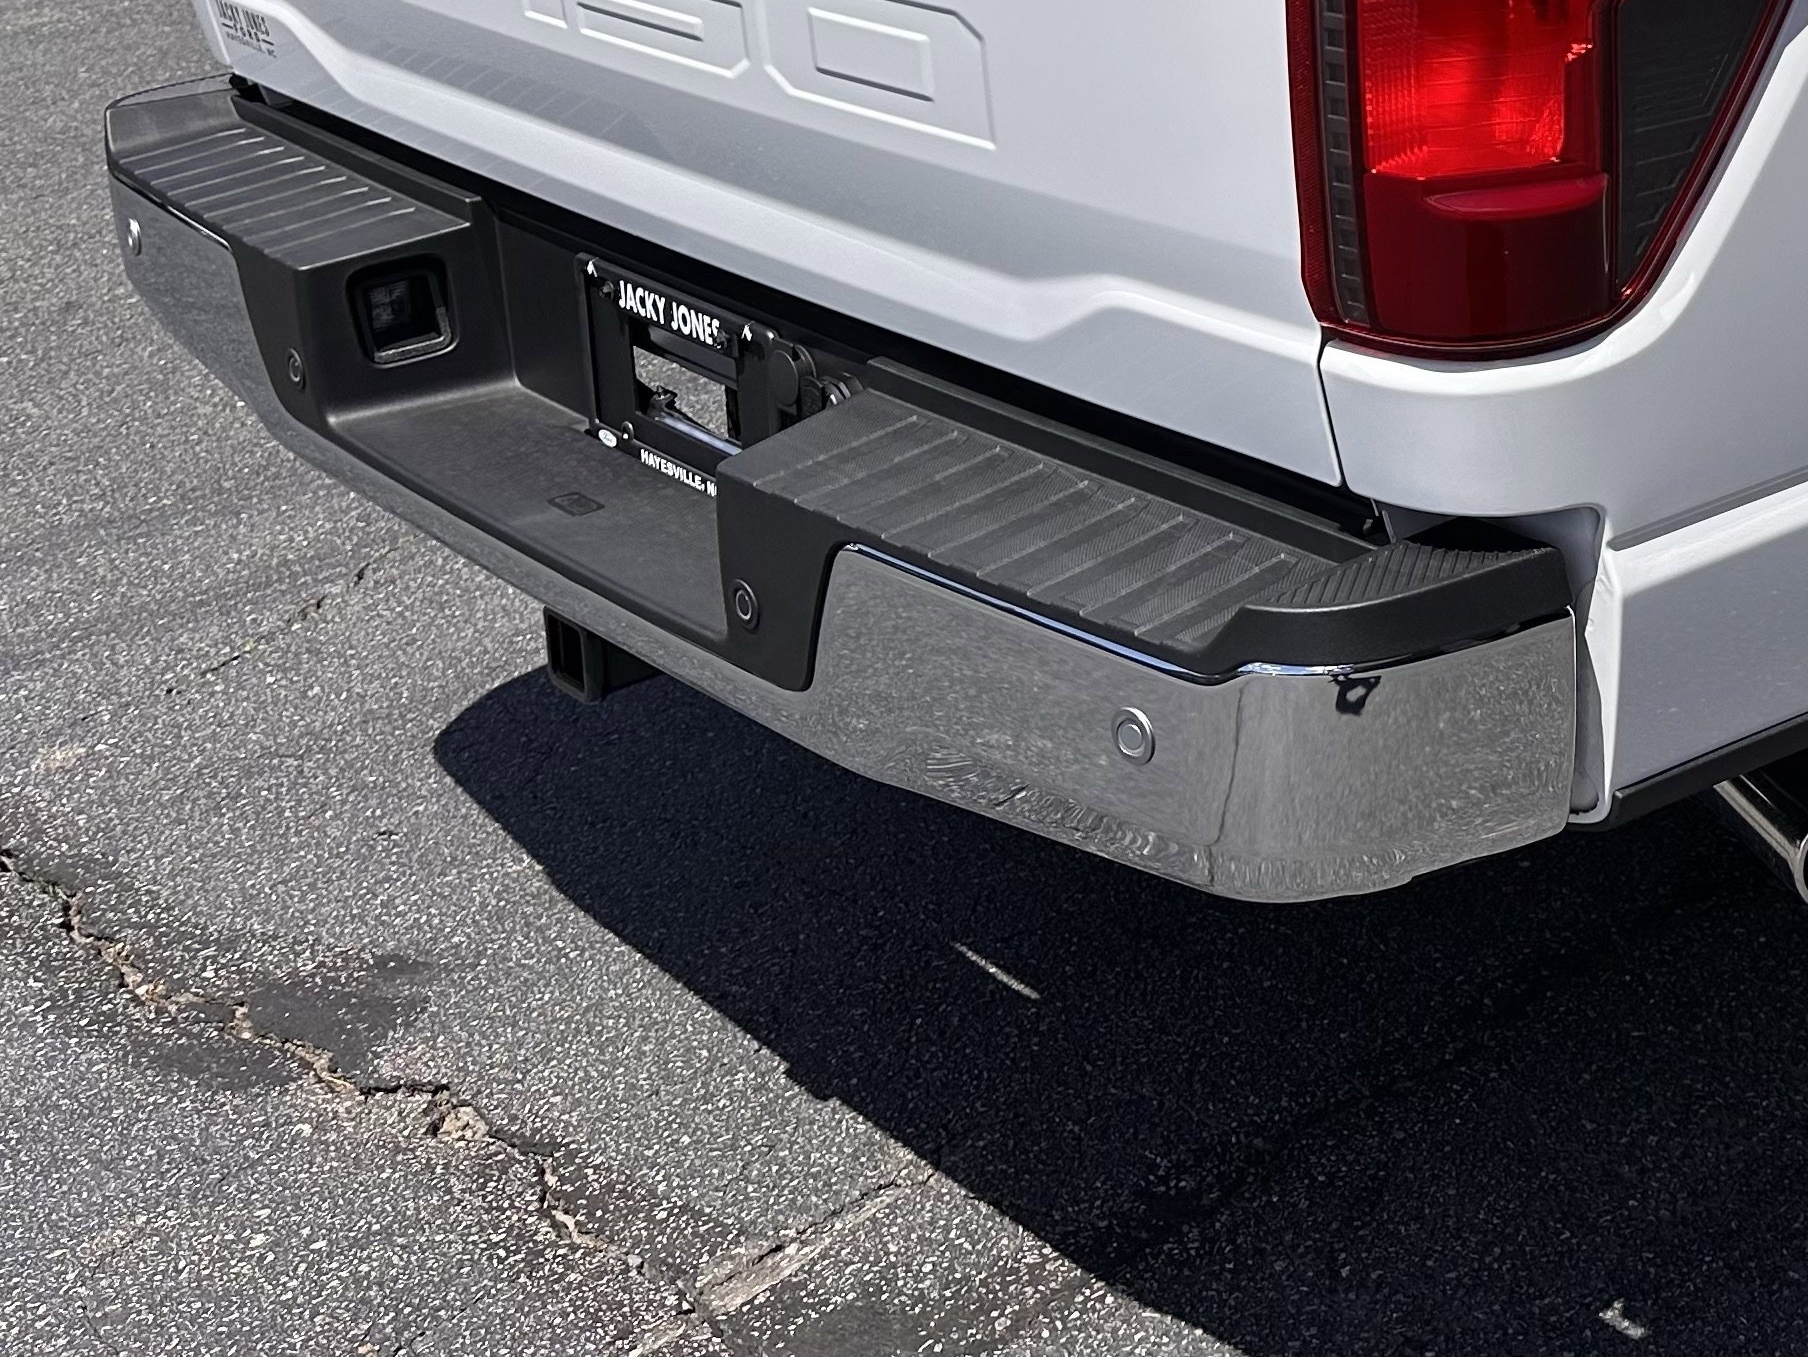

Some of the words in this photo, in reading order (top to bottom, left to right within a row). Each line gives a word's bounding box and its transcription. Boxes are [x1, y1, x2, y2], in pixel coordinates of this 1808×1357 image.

[618, 280, 666, 325] JACKY
[671, 300, 722, 349] JONES
[640, 448, 706, 492] HAYESVILLE,
[706, 480, 718, 498] N
